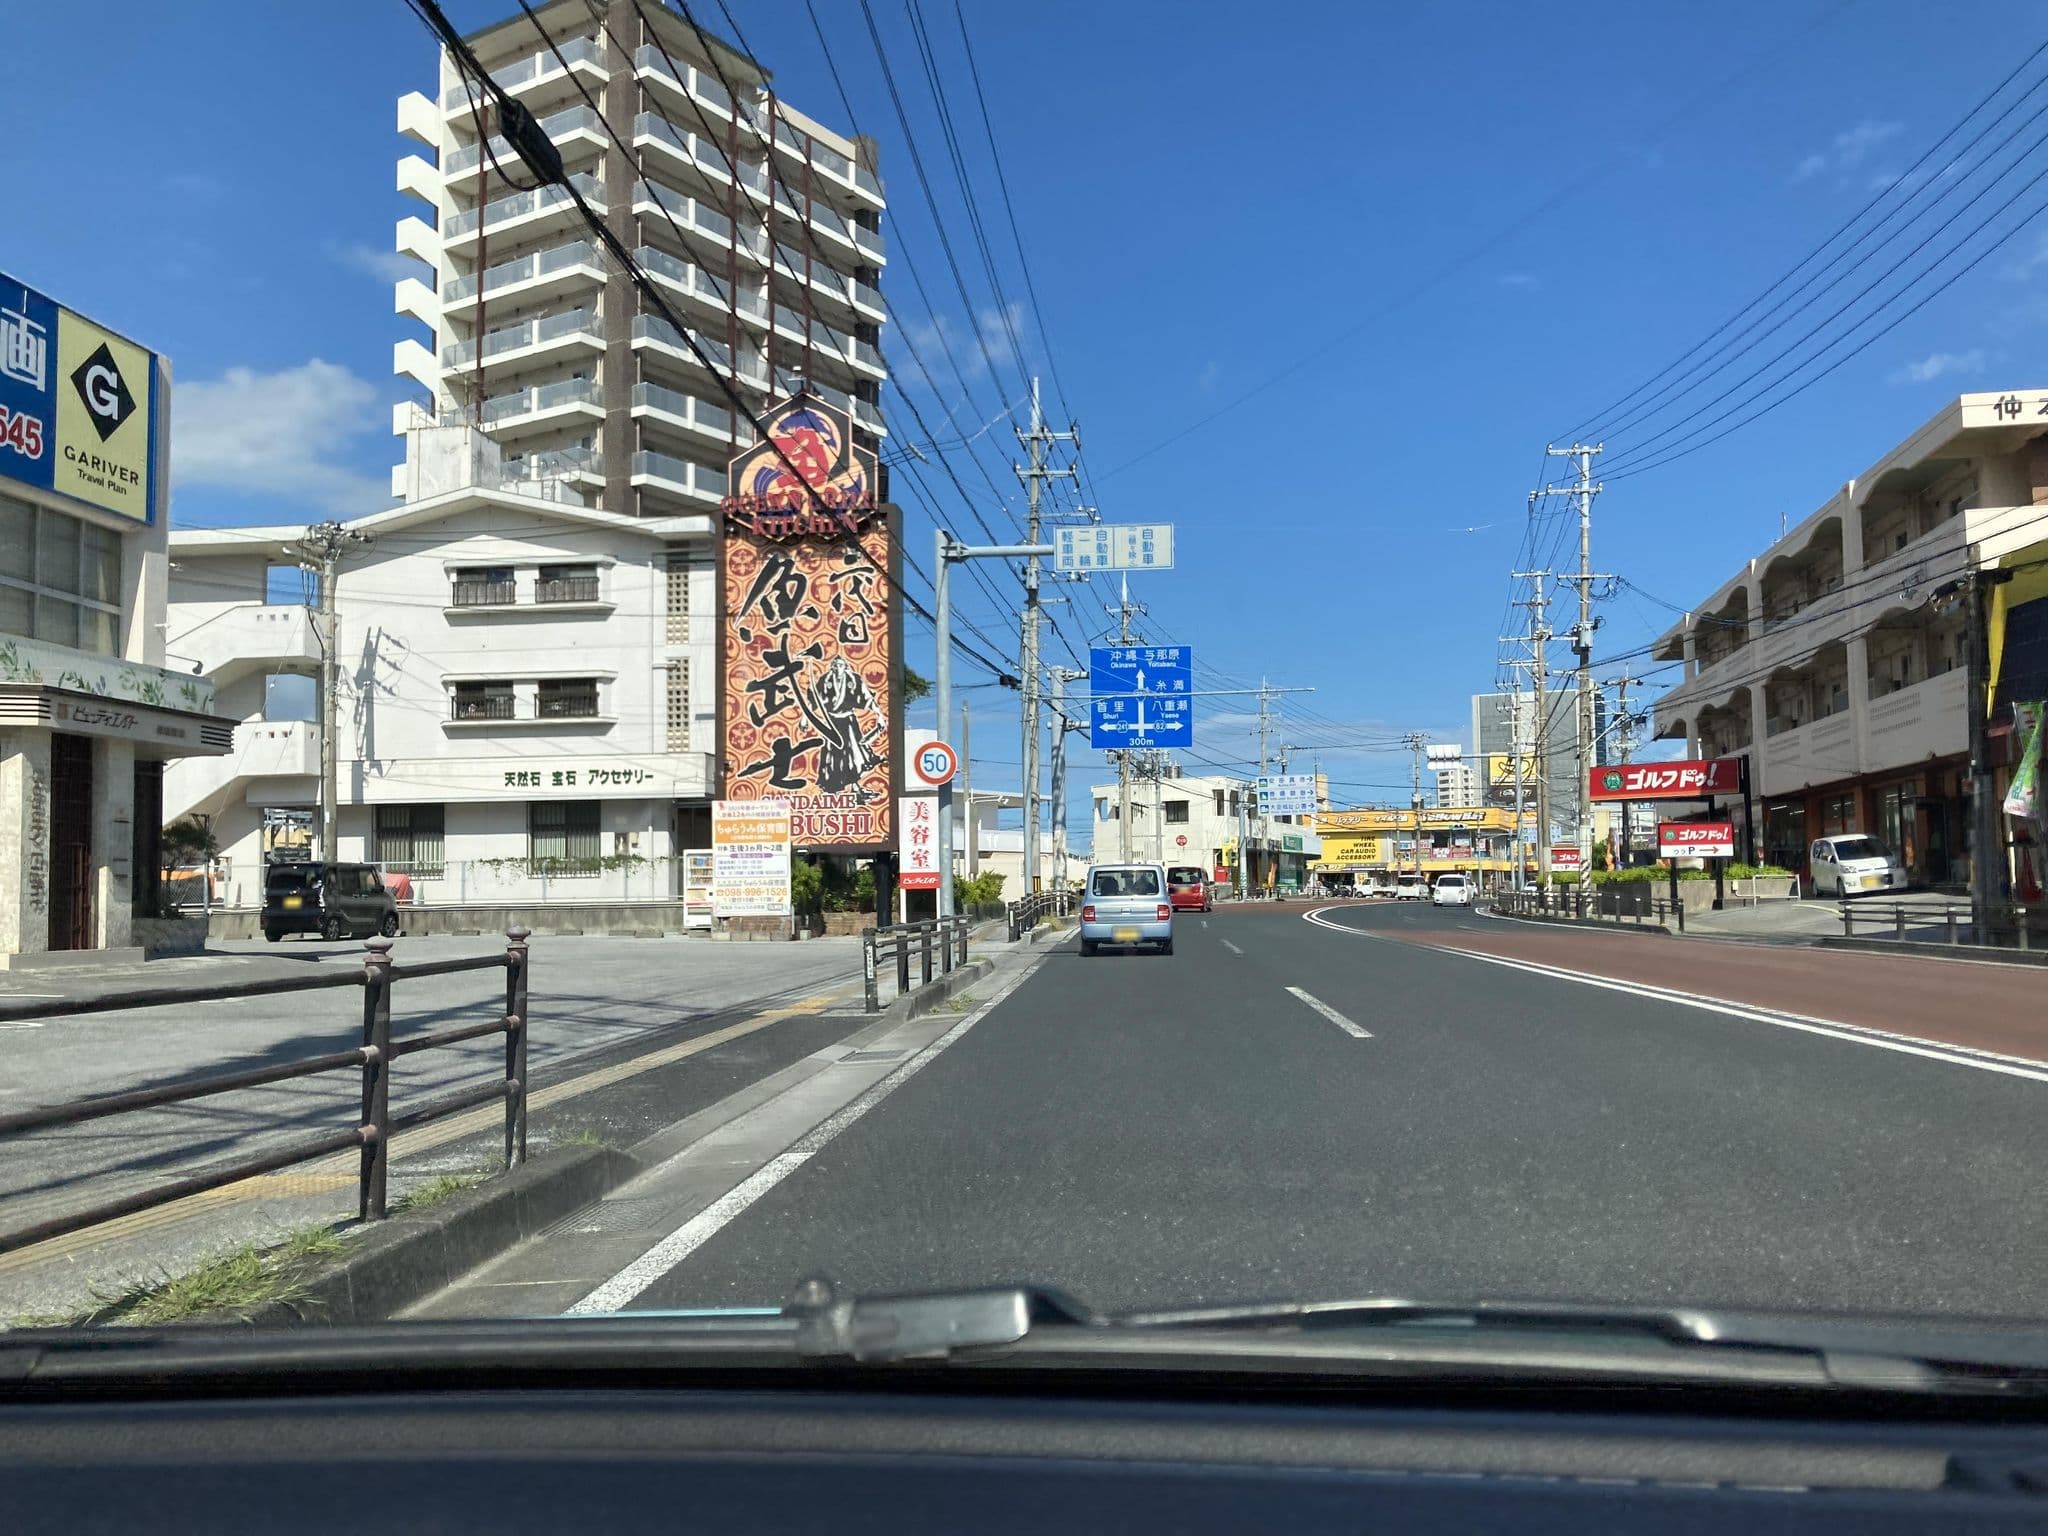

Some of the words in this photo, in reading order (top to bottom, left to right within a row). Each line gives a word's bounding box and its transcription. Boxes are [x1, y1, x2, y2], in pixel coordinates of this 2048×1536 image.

[64, 446, 139, 486] GARIVER
[77, 468, 104, 488] Travel
[108, 480, 127, 495] Plan
[1096, 529, 1108, 566] 自動車
[1142, 528, 1154, 565] 自動車
[1110, 650, 1137, 661] 沖縄
[1144, 649, 1180, 661] 与那原
[1155, 680, 1184, 691] 糸満
[1097, 701, 1126, 713] 首里
[1152, 700, 1188, 711] 八重瀬
[1102, 712, 1119, 720] Shuri
[1129, 738, 1154, 746] 300m
[923, 753, 947, 772] 50
[504, 771, 541, 787] 天然石
[552, 771, 577, 786] 宝石
[589, 769, 654, 785] アクセサリー
[790, 813, 872, 836] BUSHI
[910, 801, 930, 868] 美容室
[1559, 853, 1580, 862] ゴルフ
